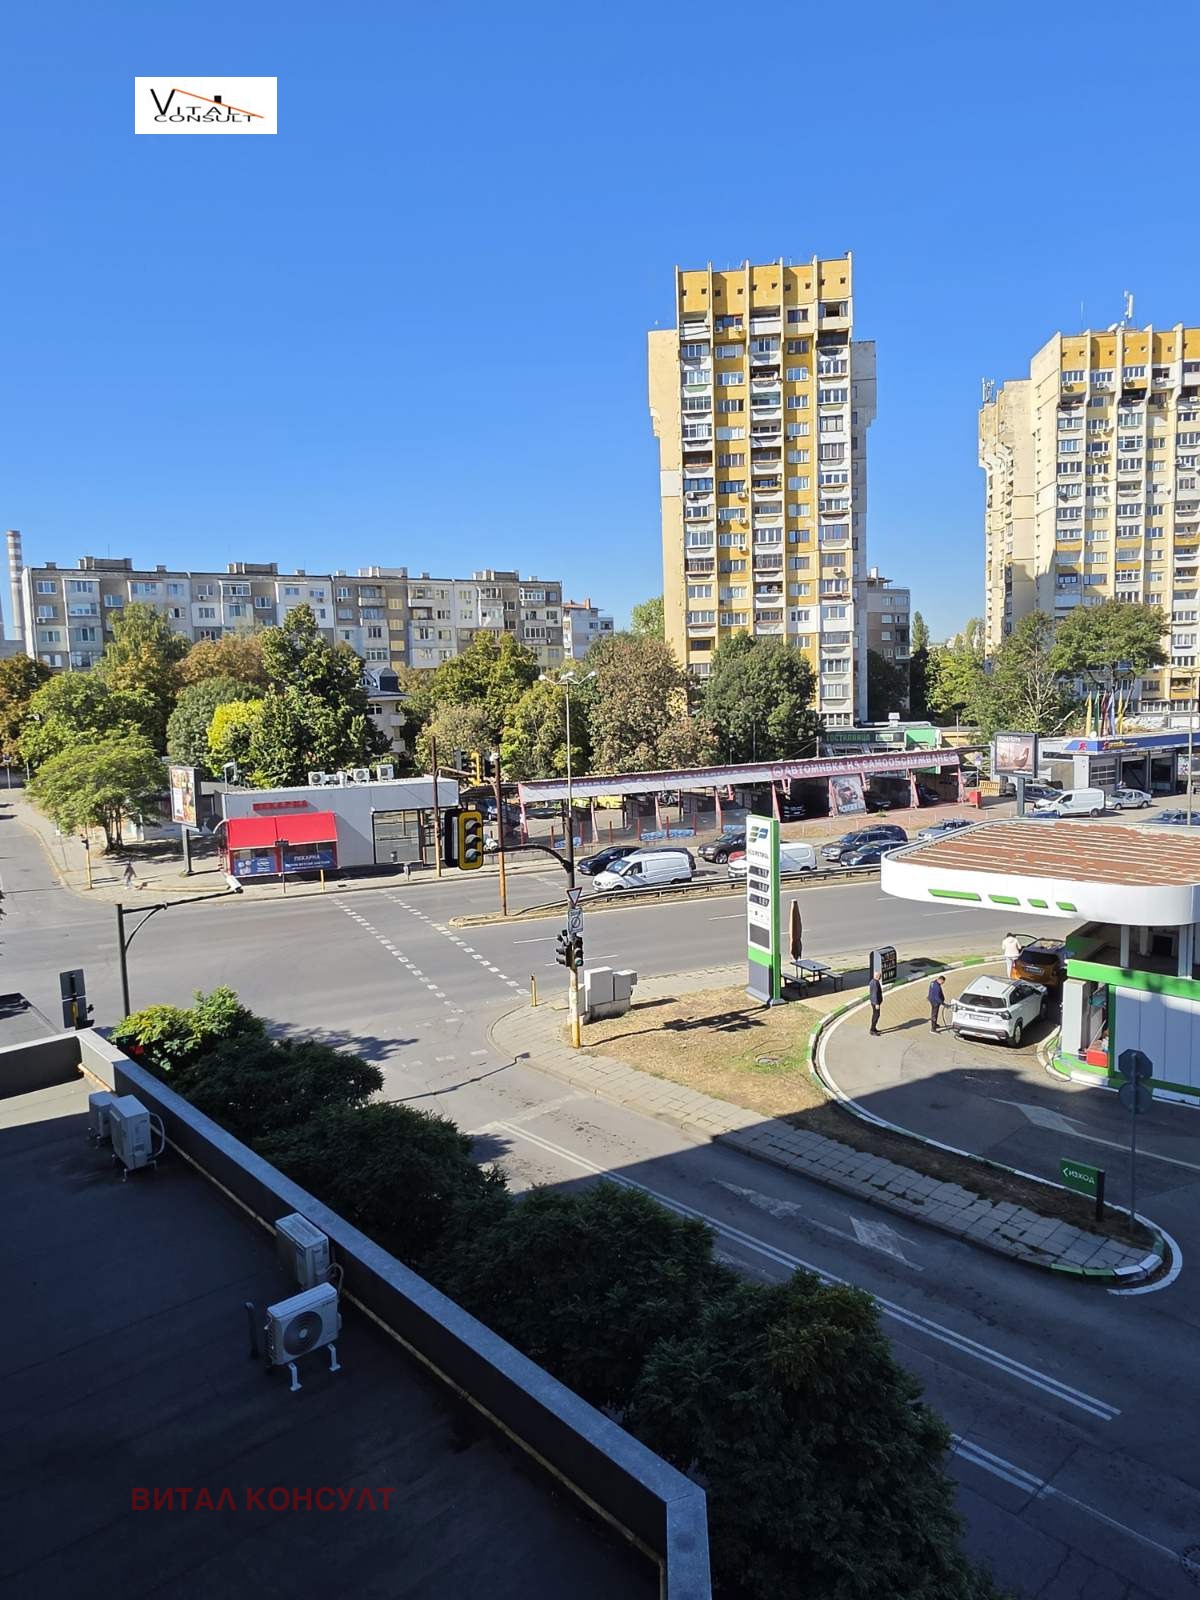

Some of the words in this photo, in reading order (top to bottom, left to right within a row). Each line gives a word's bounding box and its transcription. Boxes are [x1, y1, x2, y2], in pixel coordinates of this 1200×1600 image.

[784, 761, 845, 776] АВТОМИВКА
[846, 760, 861, 771] НА
[862, 752, 949, 769] САМООБСЛУЖВАНЕ
[1068, 1170, 1095, 1184] ИЗХОД
